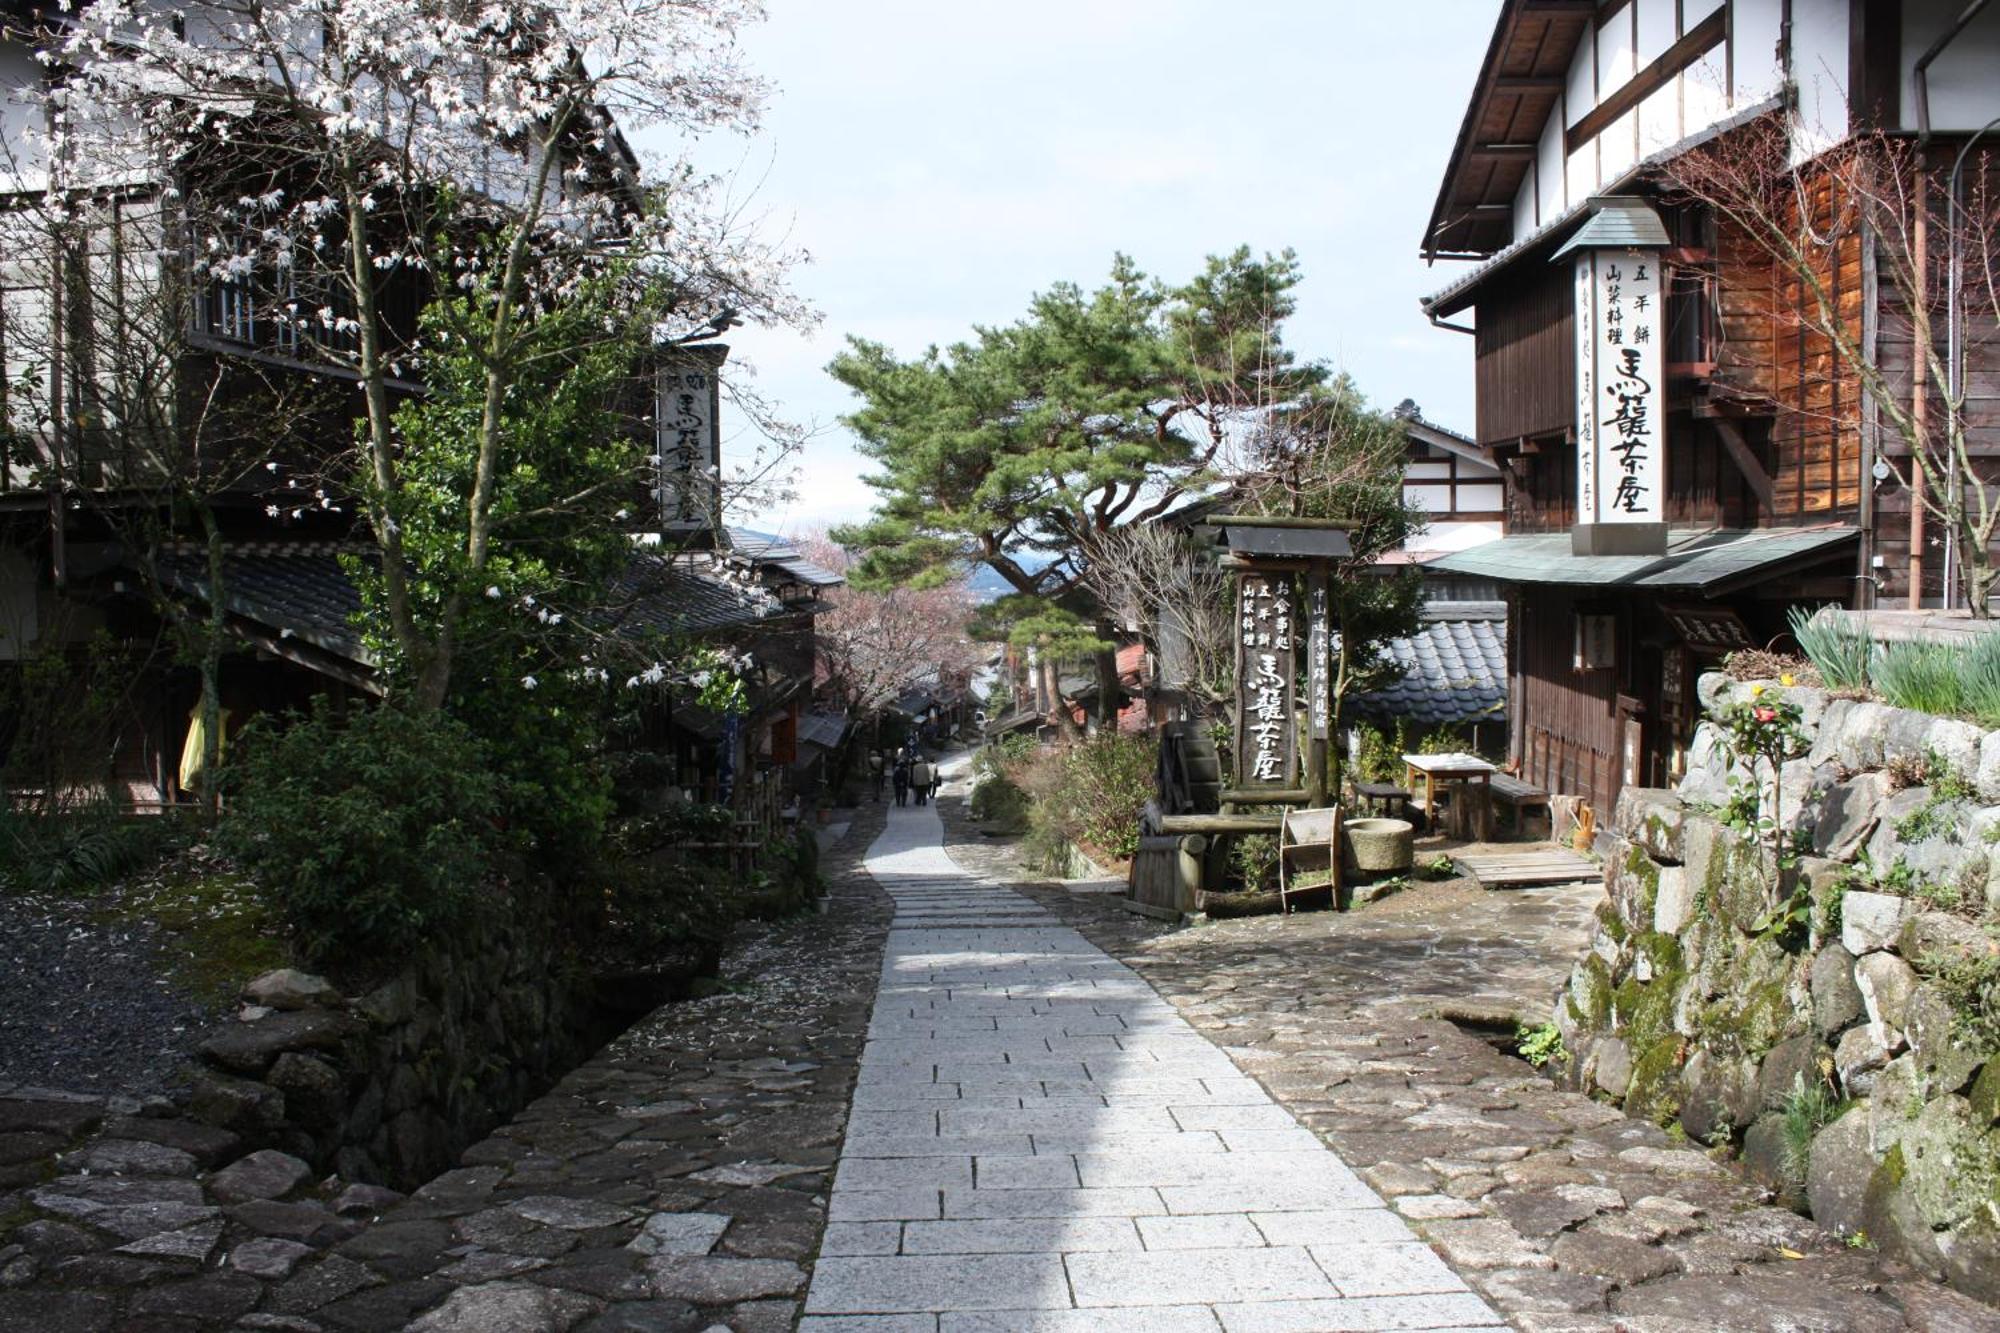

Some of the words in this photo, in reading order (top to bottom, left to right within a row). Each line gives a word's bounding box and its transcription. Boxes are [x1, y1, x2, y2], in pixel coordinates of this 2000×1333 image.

[1606, 264, 1623, 345] 山菜料理
[1633, 264, 1650, 344] 五平餅
[1602, 348, 1652, 513] 馬籠茶屋
[1242, 584, 1256, 646] 山菜料理
[1257, 585, 1272, 647] 五平餅
[1273, 580, 1291, 650] お食事処
[1245, 654, 1286, 780] 馬籠茶屋
